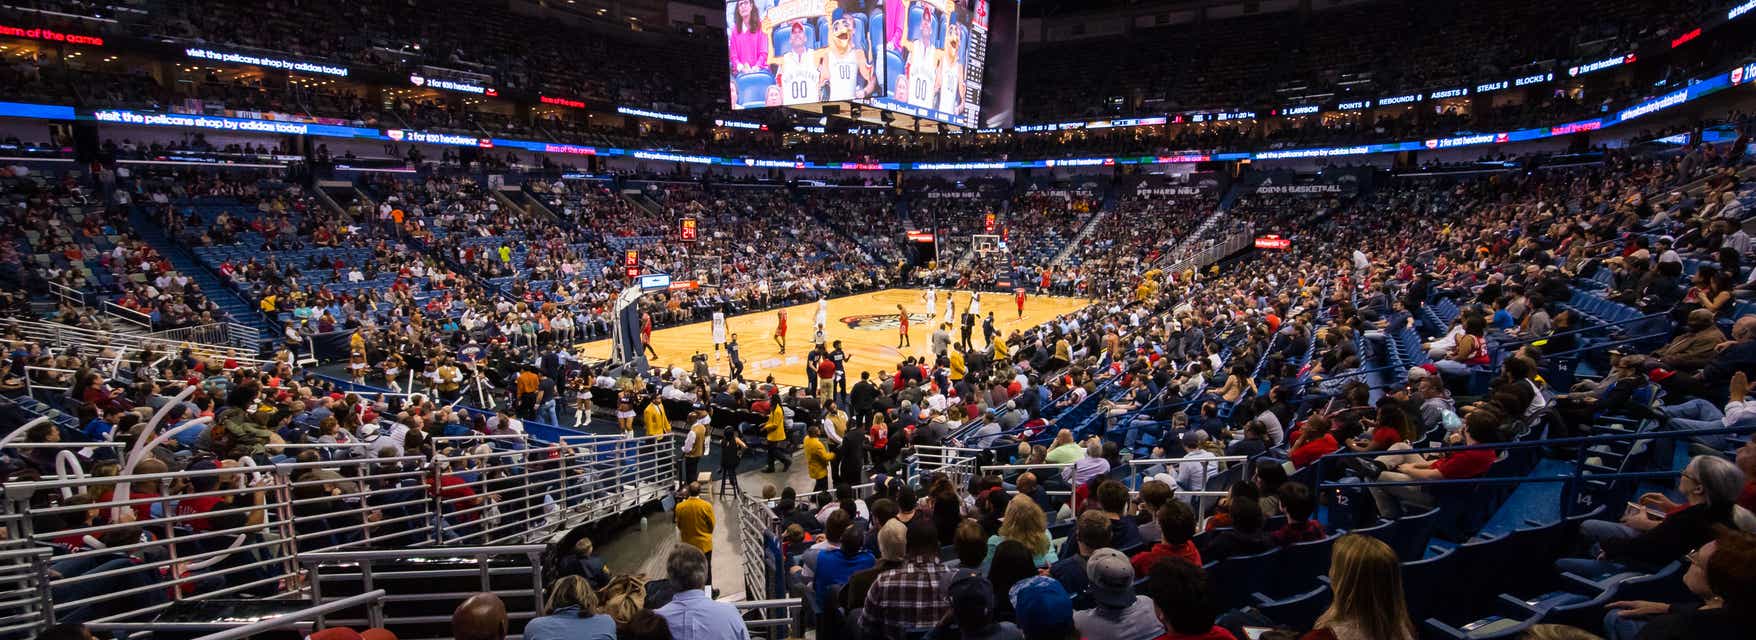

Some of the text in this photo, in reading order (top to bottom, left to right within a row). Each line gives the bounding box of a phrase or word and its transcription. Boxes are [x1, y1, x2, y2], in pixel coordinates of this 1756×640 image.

[27, 29, 40, 38] of
[42, 30, 64, 40] the
[66, 34, 103, 45] game
[186, 49, 348, 76] visit the pelicans shop by adidas today!
[840, 65, 850, 79] 00
[432, 79, 442, 87] for
[454, 82, 484, 93] headwear
[1516, 75, 1544, 85] BLOCKS
[792, 81, 807, 99] 00
[1431, 89, 1460, 98] ASSISTS
[1477, 83, 1500, 92] STEALS
[1379, 95, 1414, 105] REBOUNDS
[1290, 106, 1318, 114] LAWSON
[96, 111, 306, 134] visit the pelicans shop by adidas today!
[414, 132, 425, 141] for
[440, 134, 477, 145] headwear
[1462, 135, 1494, 144] headwear
[683, 227, 695, 238] 24
[1337, 495, 1349, 506] 12
[1577, 493, 1592, 506] 14
